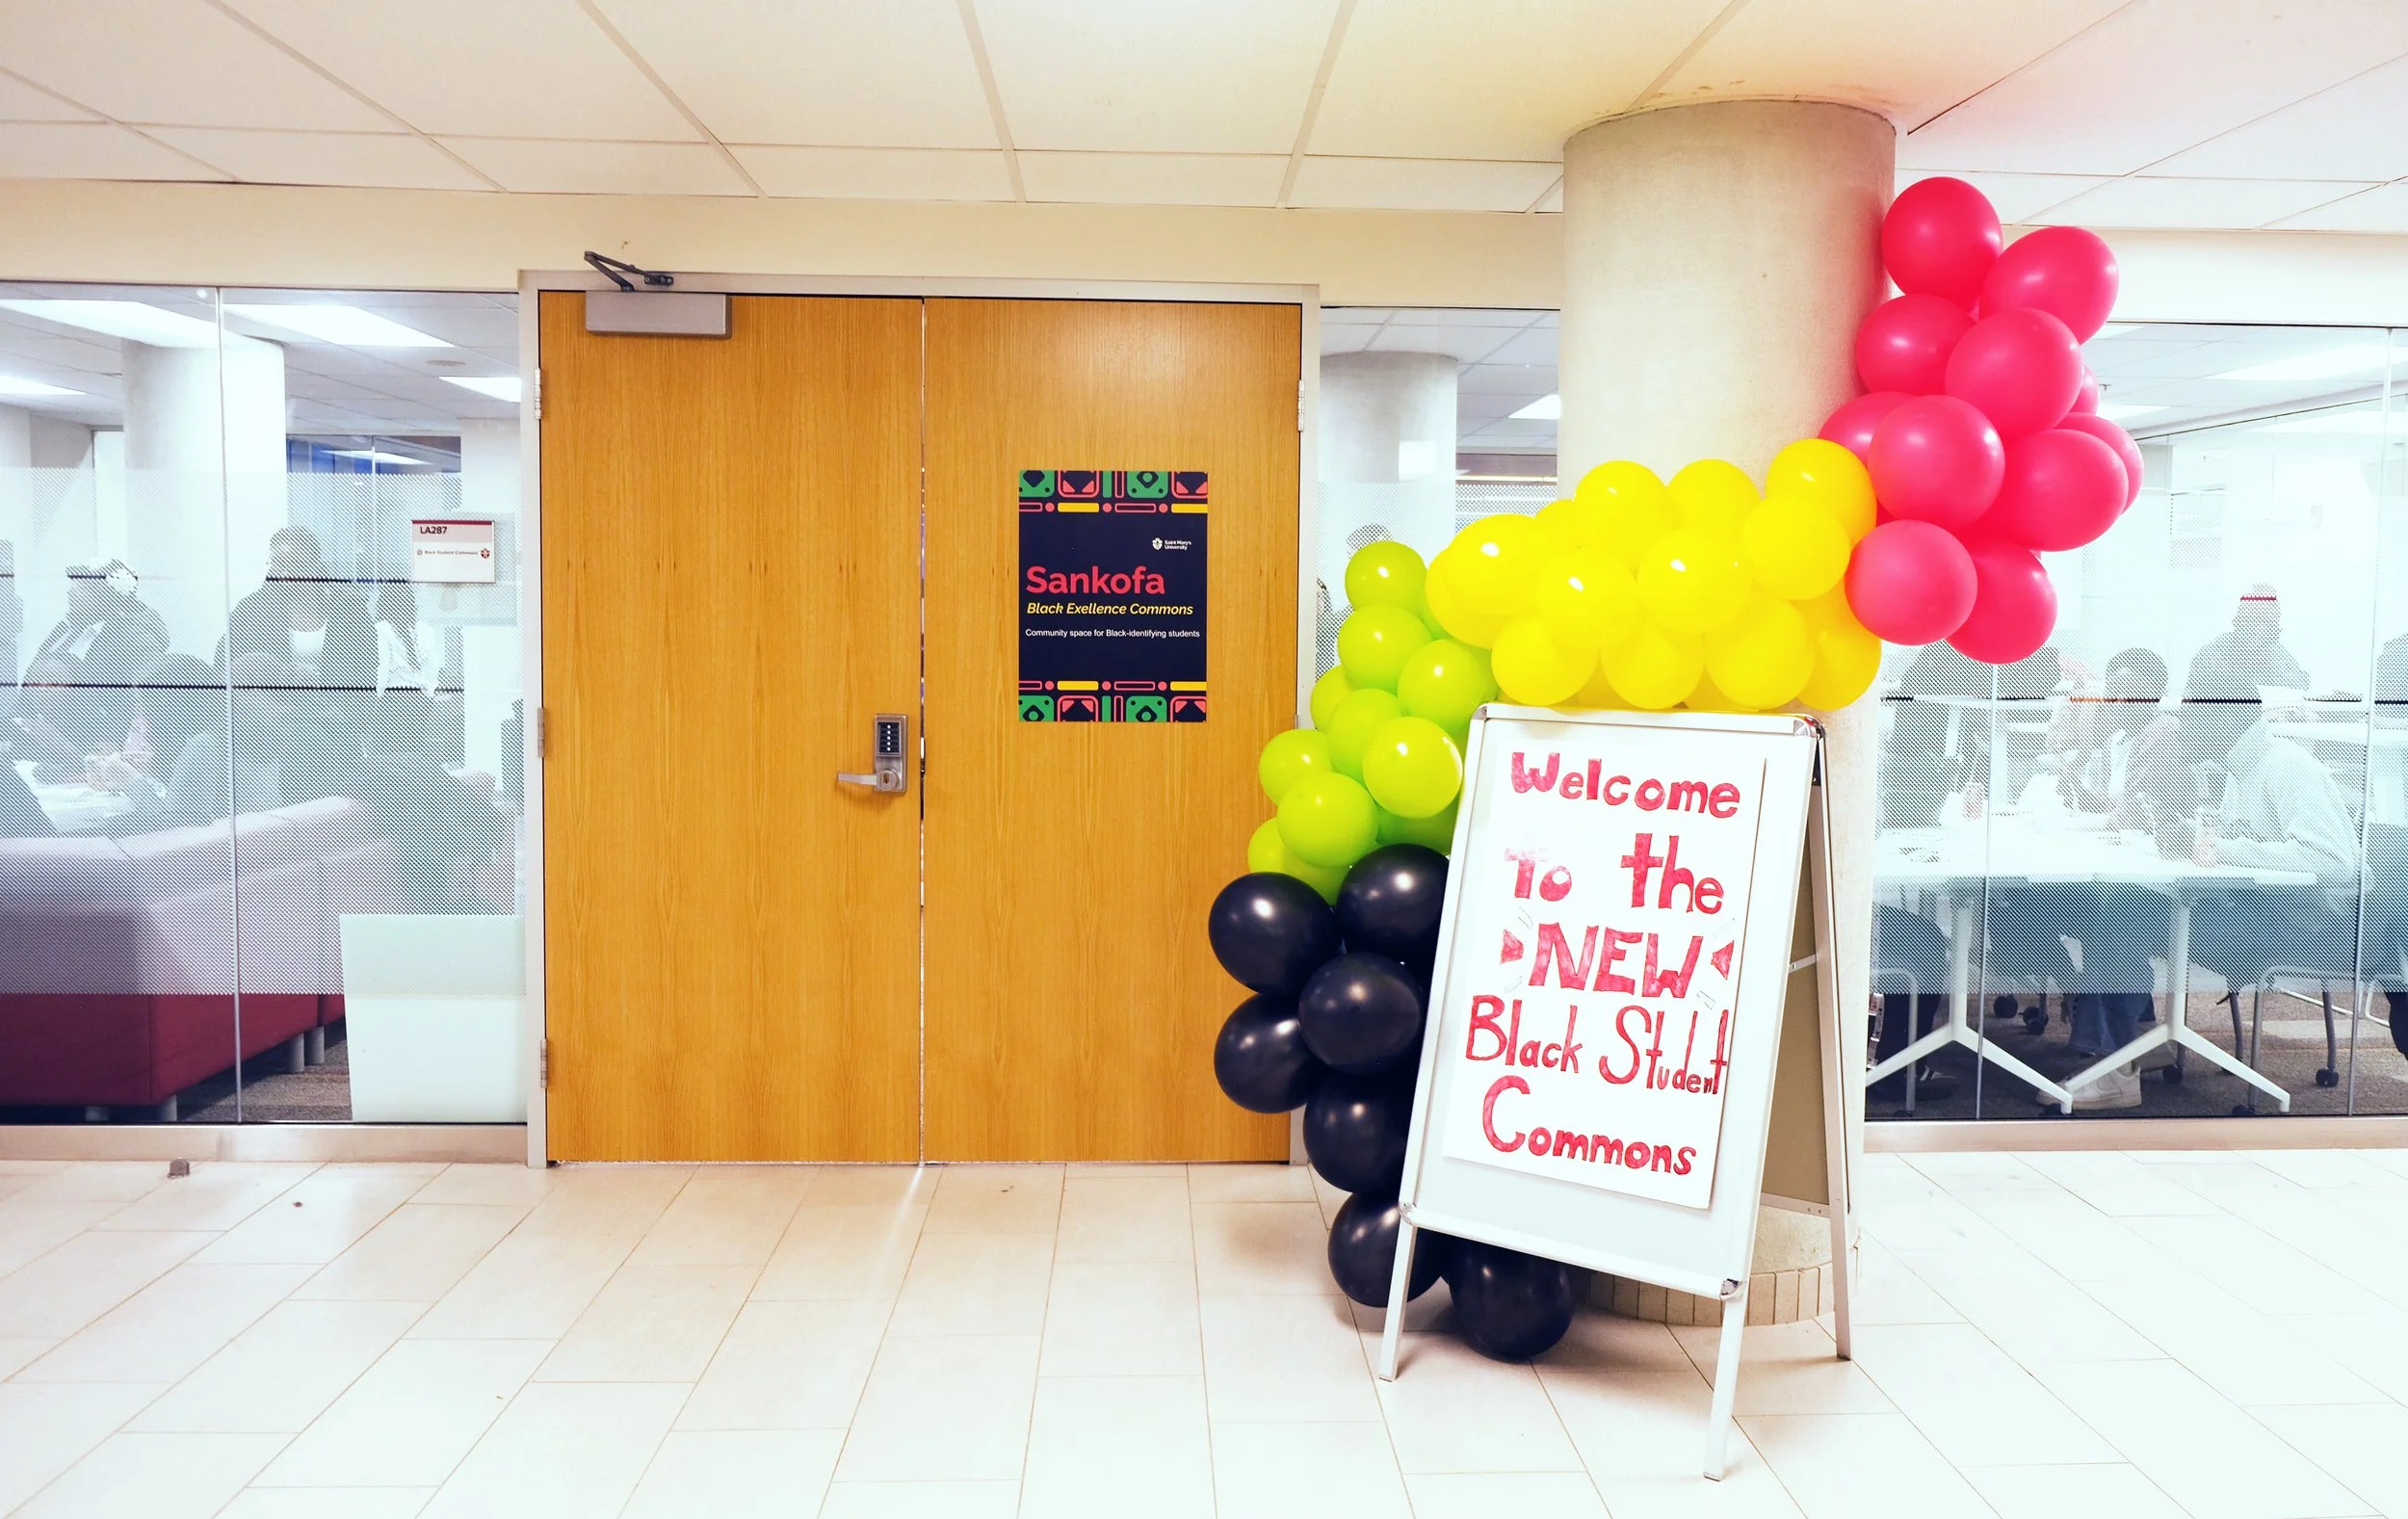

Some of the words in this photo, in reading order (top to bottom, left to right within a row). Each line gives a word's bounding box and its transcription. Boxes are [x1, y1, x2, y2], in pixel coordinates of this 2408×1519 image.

[420, 526, 448, 535] LA287
[1026, 565, 1165, 594] Sankofa
[1027, 602, 1063, 615] Black
[1066, 603, 1127, 615] Exellence
[1130, 603, 1193, 615] Commons
[1025, 628, 1068, 639] Community
[1093, 629, 1104, 638] for
[1106, 629, 1166, 639] Black-identifying
[1168, 629, 1201, 638] students
[1511, 752, 1741, 819] Welcome
[1505, 847, 1573, 903] To
[1621, 833, 1724, 915] the
[1529, 922, 1703, 999] NEW
[1465, 995, 1583, 1073] Black
[1599, 1005, 1729, 1095] Student
[1482, 1074, 1697, 1176] Commons
